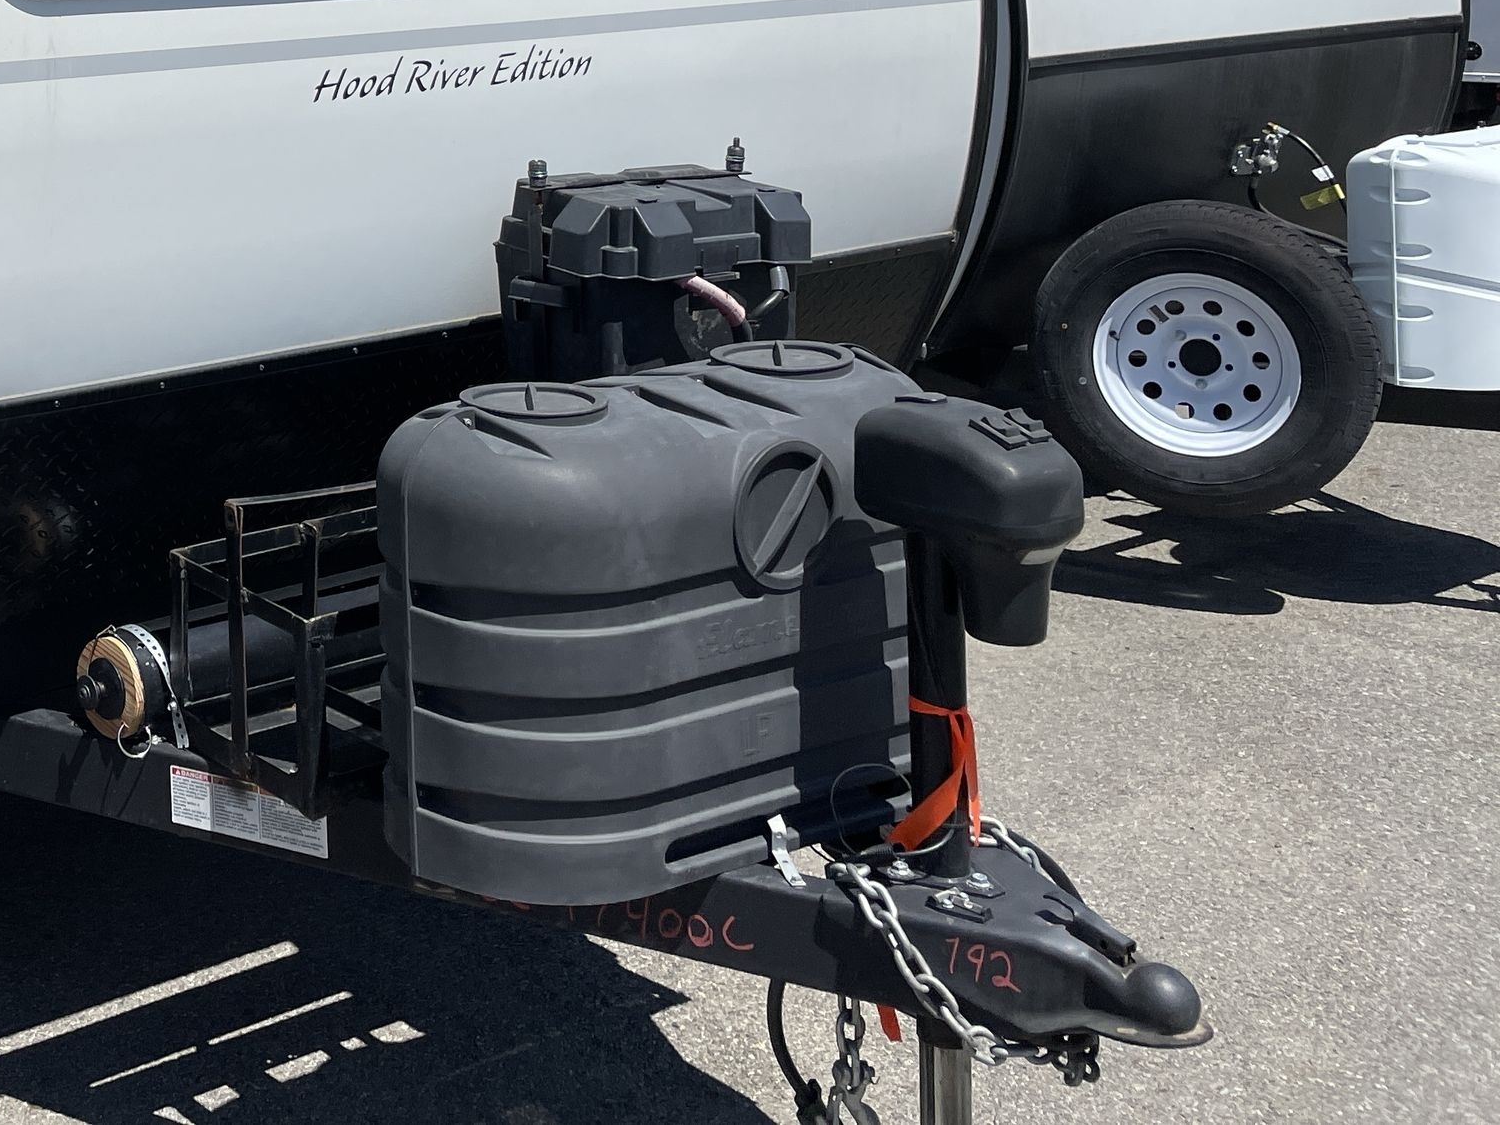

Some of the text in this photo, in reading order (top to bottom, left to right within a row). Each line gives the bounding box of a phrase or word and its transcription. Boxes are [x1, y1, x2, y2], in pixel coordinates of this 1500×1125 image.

[313, 44, 593, 103] Hood River Edition
